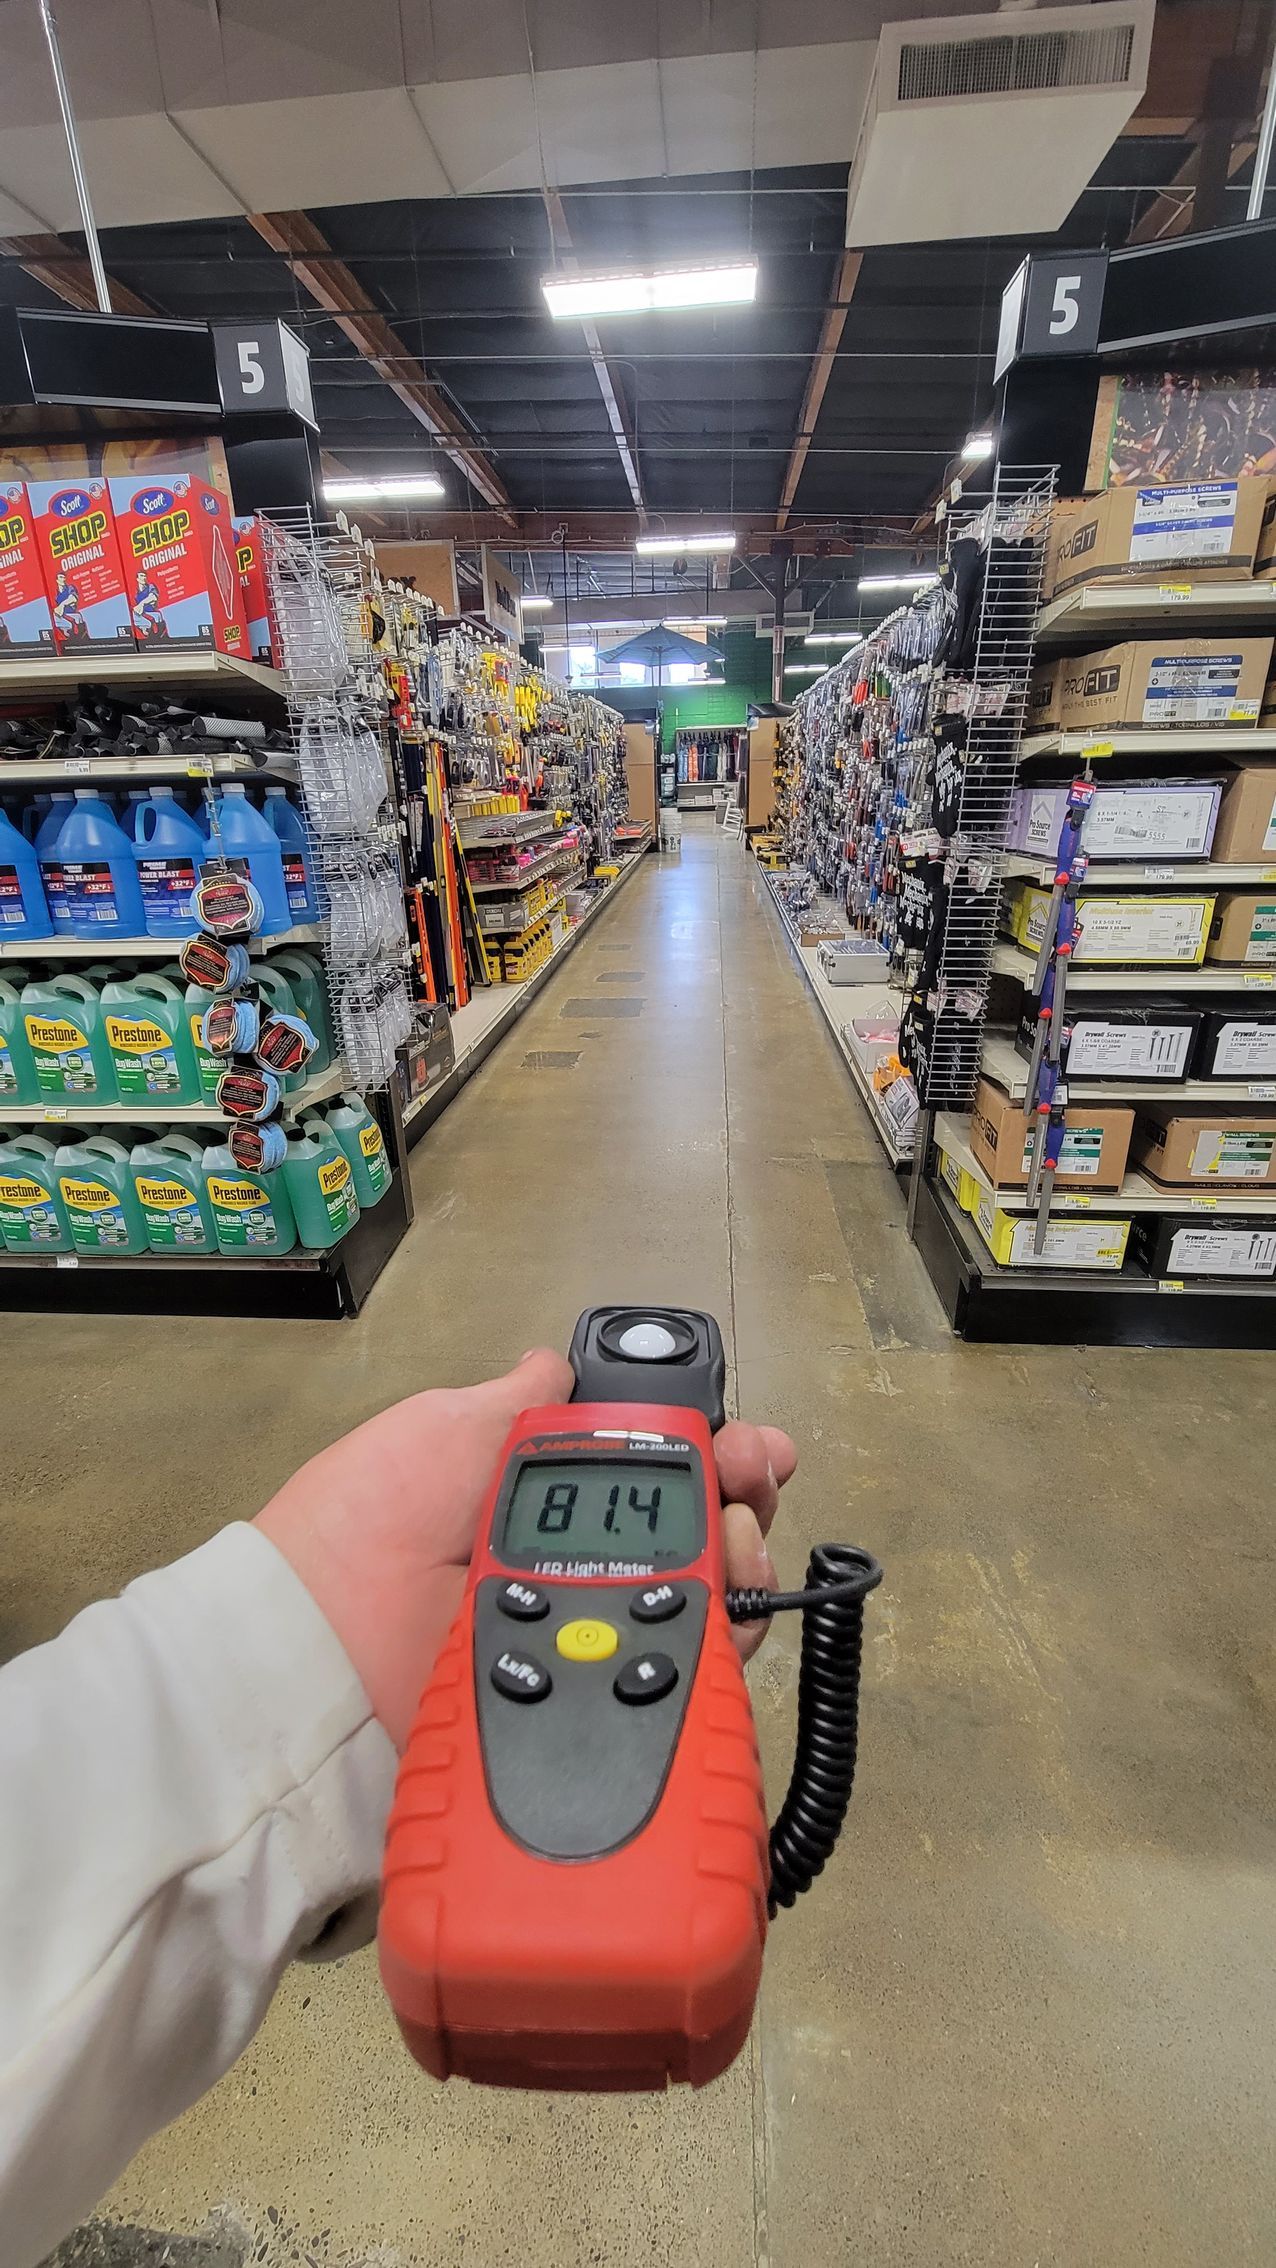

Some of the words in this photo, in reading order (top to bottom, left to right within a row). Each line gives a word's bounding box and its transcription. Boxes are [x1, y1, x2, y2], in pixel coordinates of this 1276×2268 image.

[1049, 275, 1082, 335] 5
[237, 341, 266, 395] 5
[1198, 484, 1222, 493] SCREWS
[60, 494, 82, 516] Scott
[143, 493, 165, 514] Scott
[204, 496, 215, 511] Scott
[0, 515, 25, 550] OP
[50, 510, 107, 558] SHOP
[131, 509, 190, 558] SHOP
[0, 548, 24, 571] GINAL
[61, 544, 105, 572] ORIGINAL
[142, 543, 188, 571] ORIGINAL
[224, 626, 241, 642] SHOP
[1105, 696, 1118, 704] FIT
[1036, 819, 1051, 831] Source
[30, 1024, 78, 1042] Prestone
[111, 1025, 162, 1043] Prestone
[1233, 1030, 1257, 1038] Drywall
[322, 1160, 348, 1189] Prestone
[0, 1184, 42, 1198] restone
[65, 1186, 111, 1202] Prestone
[141, 1185, 187, 1201] Prestone
[212, 1185, 261, 1201] Prestone
[541, 1439, 626, 1451] AMPROBE
[628, 1442, 690, 1452] LM-200LED
[536, 1482, 662, 1535] 81.4
[566, 1560, 604, 1578] Light
[608, 1561, 654, 1578] Meter
[506, 1582, 538, 1607] M-H
[642, 1584, 674, 1607] D-H
[637, 1660, 657, 1681] R
